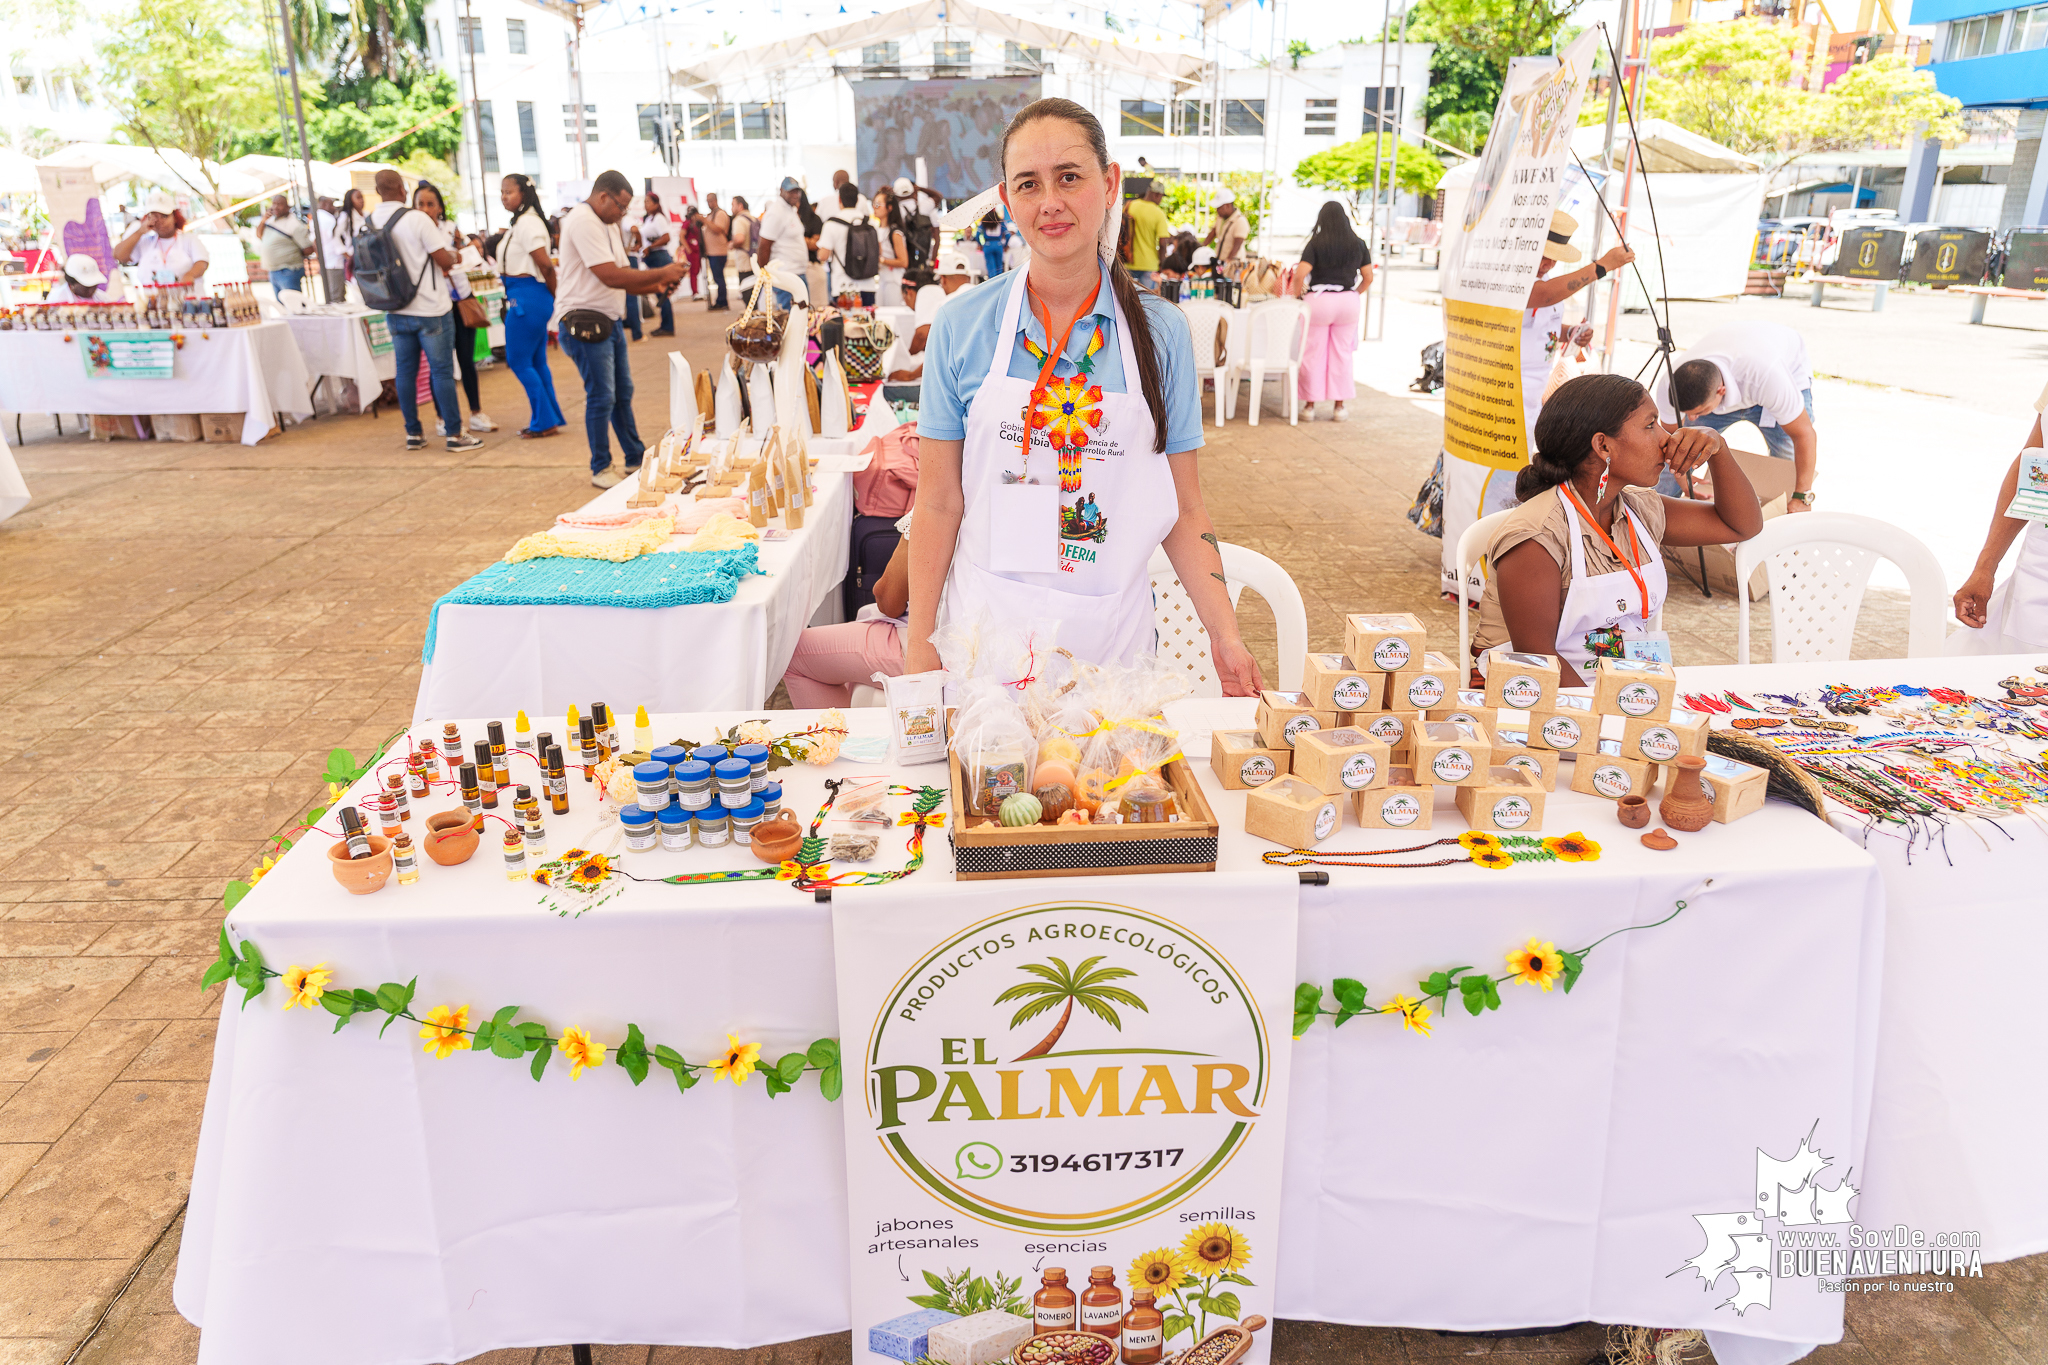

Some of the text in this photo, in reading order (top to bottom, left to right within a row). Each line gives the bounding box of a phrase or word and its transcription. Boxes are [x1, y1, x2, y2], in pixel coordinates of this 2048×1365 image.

[1514, 236, 1539, 251] Tierra
[1497, 380, 1506, 389] por
[1508, 381, 1514, 389] la
[1486, 396, 1515, 408] ancestral.
[1494, 414, 1515, 424] juntos
[1000, 421, 1038, 435] Gobieno
[1483, 428, 1510, 442] indígena
[1512, 436, 1517, 444] y
[1491, 449, 1519, 460] unidad.
[1374, 651, 1409, 659] PALMAR
[1334, 690, 1368, 699] PALMAR
[1409, 688, 1442, 697] PALMAR
[1504, 689, 1540, 697] PALMAR
[1619, 696, 1656, 705] PALMAR
[1543, 727, 1579, 741] PALMAR
[1641, 740, 1677, 751] PALMAR
[1434, 761, 1471, 772] PALMAR
[1342, 768, 1375, 778] PALMAR
[1594, 774, 1628, 793] PALMAR
[900, 924, 1229, 1022] PRODUCTOS AGROECOLÓGICOS
[940, 1038, 998, 1064] EL
[871, 1063, 1261, 1130] PALMAR
[1010, 1148, 1184, 1173] 3194617317
[1179, 1207, 1256, 1222] semillas
[874, 1218, 954, 1237] jabones
[868, 1235, 979, 1254] artesanales
[1024, 1240, 1107, 1253] esencias
[1038, 1312, 1072, 1320] ROMERO
[1084, 1310, 1120, 1319] LAVANDA
[1129, 1335, 1156, 1344] MENTA
